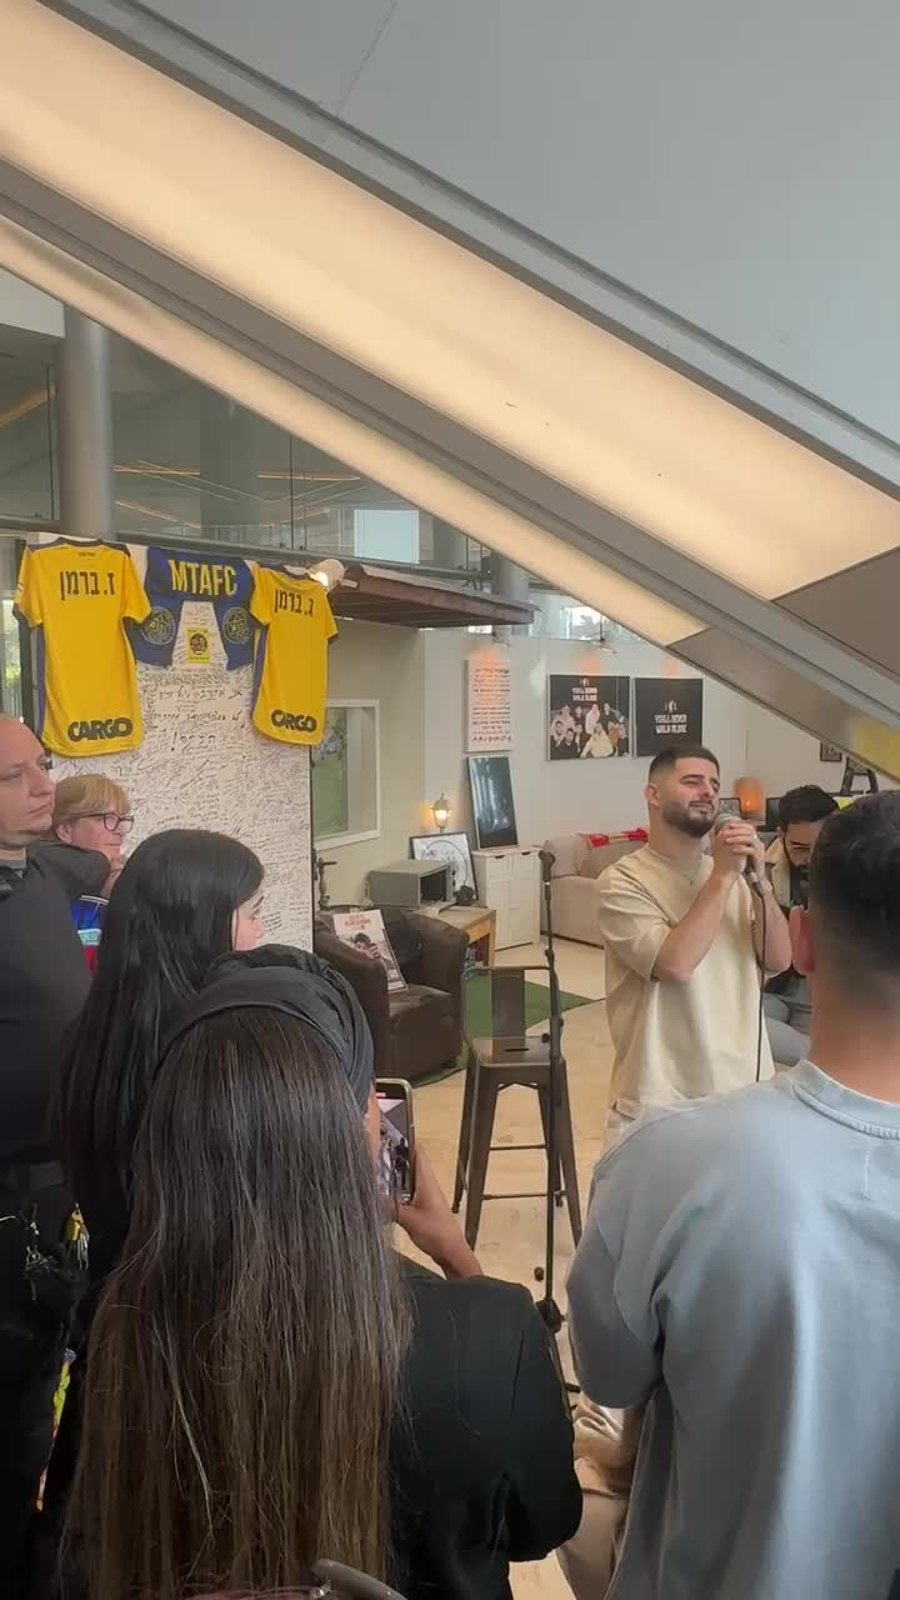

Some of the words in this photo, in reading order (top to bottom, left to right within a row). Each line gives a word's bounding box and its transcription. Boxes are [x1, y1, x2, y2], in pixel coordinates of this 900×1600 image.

[60, 571, 100, 601] ברמן
[168, 560, 237, 596] MTAFC
[274, 589, 302, 613] ברמן
[67, 717, 133, 742] CARGO
